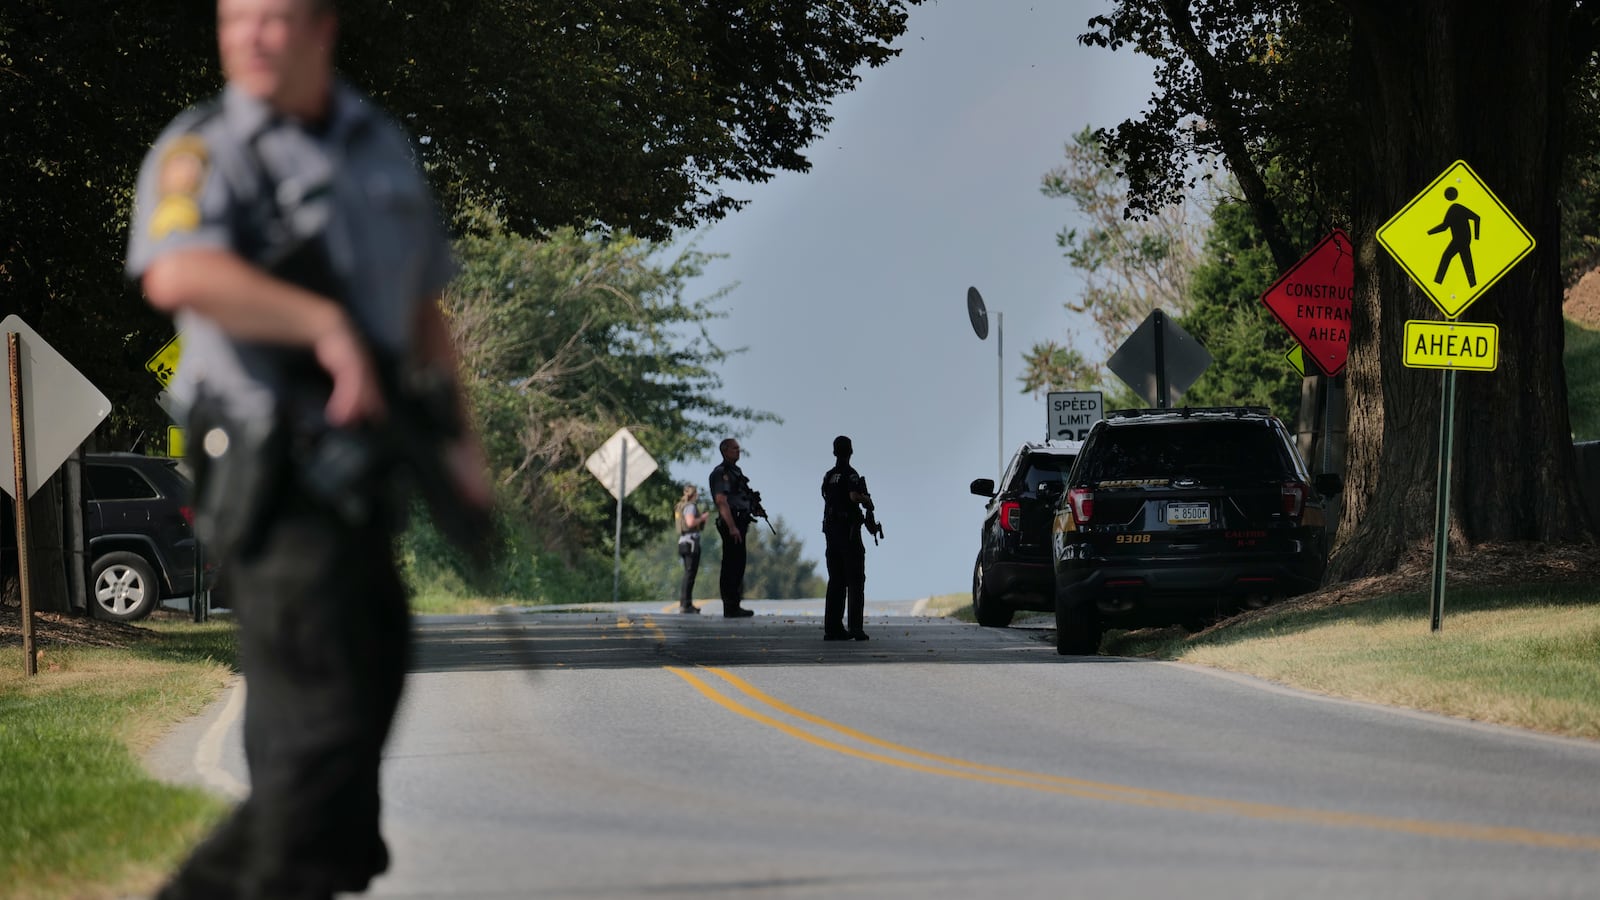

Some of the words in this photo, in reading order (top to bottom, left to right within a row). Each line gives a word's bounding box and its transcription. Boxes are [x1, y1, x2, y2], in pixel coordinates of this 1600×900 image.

[1414, 333, 1488, 358] AHEAD
[1054, 399, 1097, 411] SPEED
[1059, 414, 1091, 425] LIMIT
[1115, 534, 1151, 544] 9308
